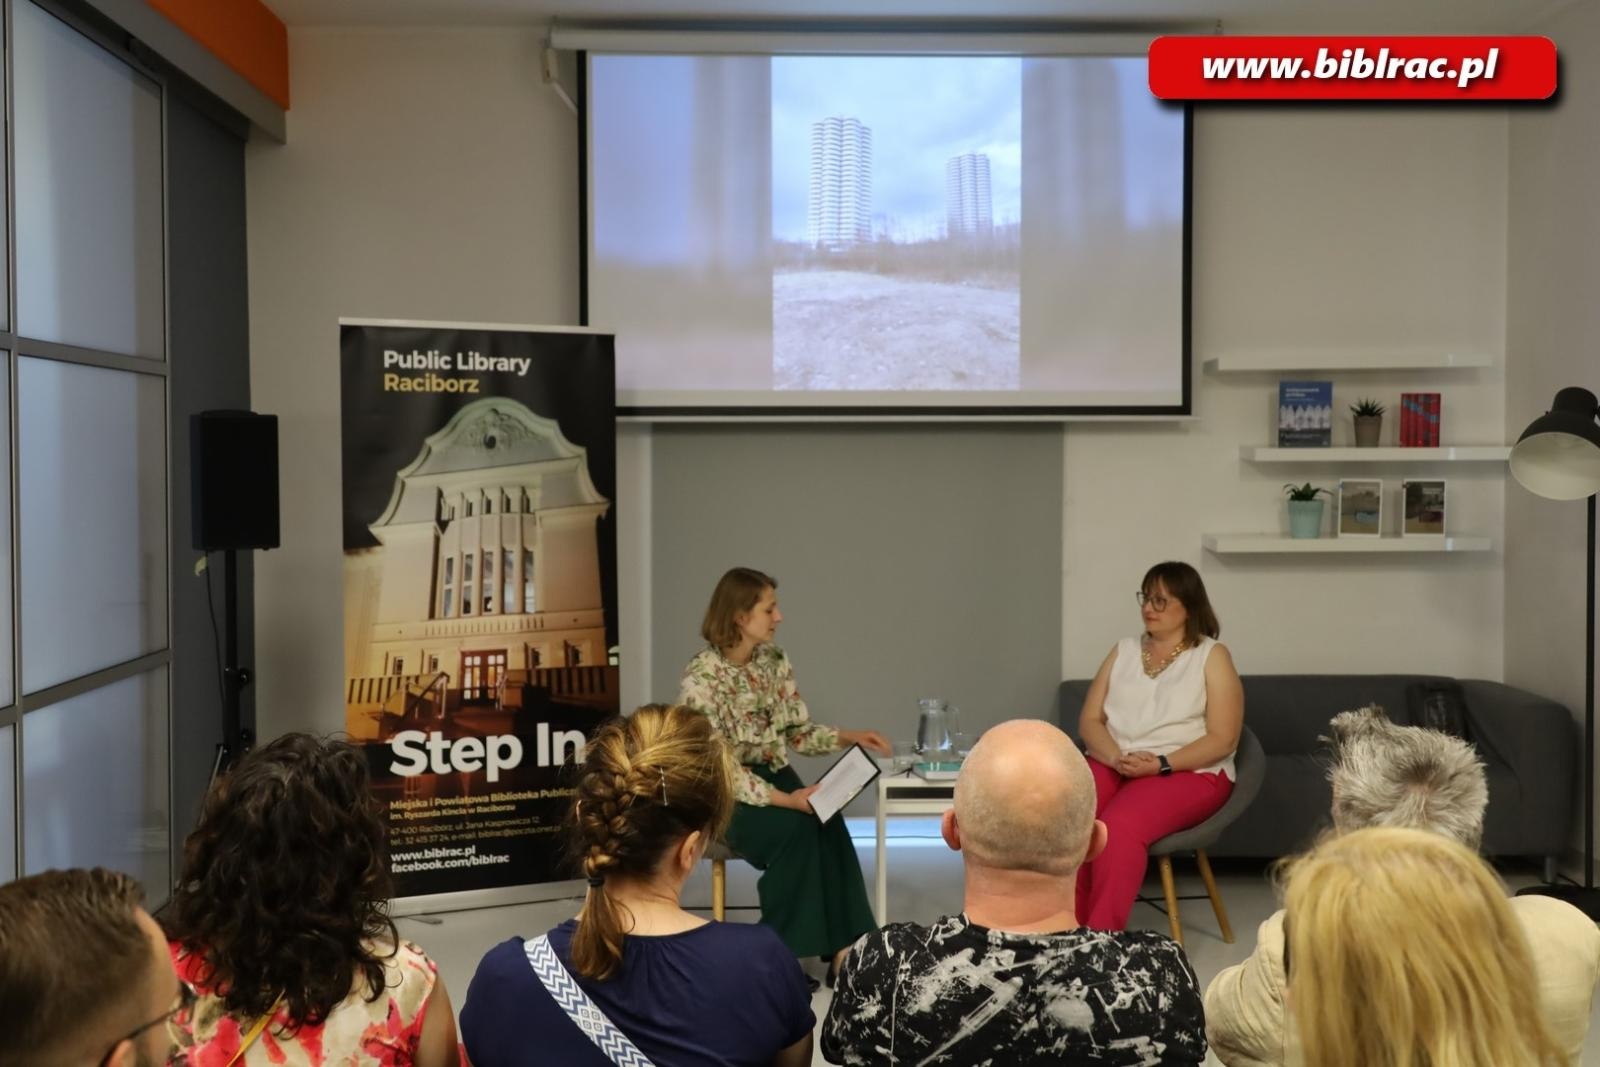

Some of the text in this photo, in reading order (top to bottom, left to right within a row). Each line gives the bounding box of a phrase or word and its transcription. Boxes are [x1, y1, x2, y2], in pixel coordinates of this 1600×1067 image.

[383, 350, 531, 376] Public Library
[383, 373, 480, 393] Raciborz
[389, 722, 587, 783] Step In
[390, 799, 428, 810] Miejska
[434, 795, 489, 806] Powiatowa
[490, 791, 539, 802] Biblioteka
[390, 812, 403, 820] im.
[404, 810, 441, 820] Ryszarda
[476, 804, 516, 813] Raciborzu
[465, 821, 484, 829] Jana
[391, 845, 476, 861] www.biblrac.pl
[391, 853, 510, 874] facebook.com/biblrac
